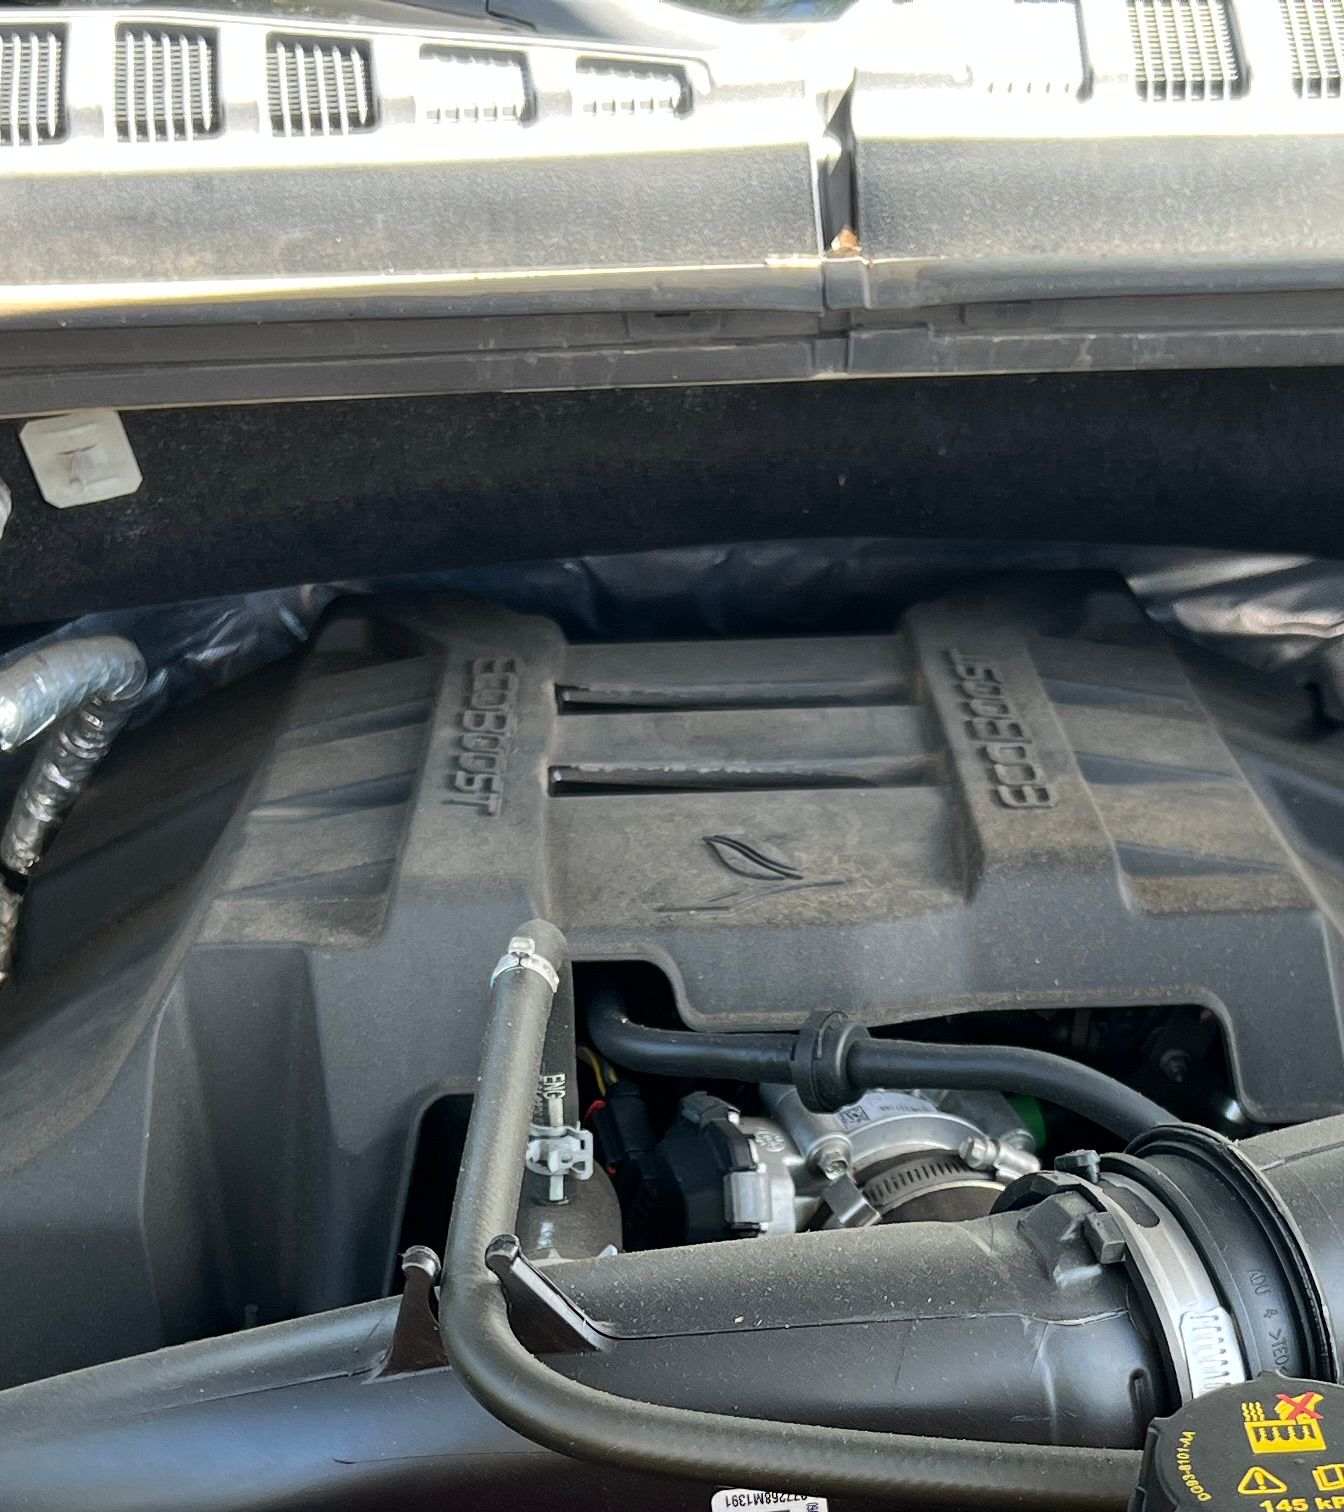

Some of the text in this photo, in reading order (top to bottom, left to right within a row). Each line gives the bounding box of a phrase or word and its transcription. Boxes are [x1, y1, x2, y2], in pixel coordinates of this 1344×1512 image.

[447, 656, 522, 817] ECOBOOST
[948, 648, 1057, 809] ECOBOOST
[1259, 1498, 1309, 1512] 145
